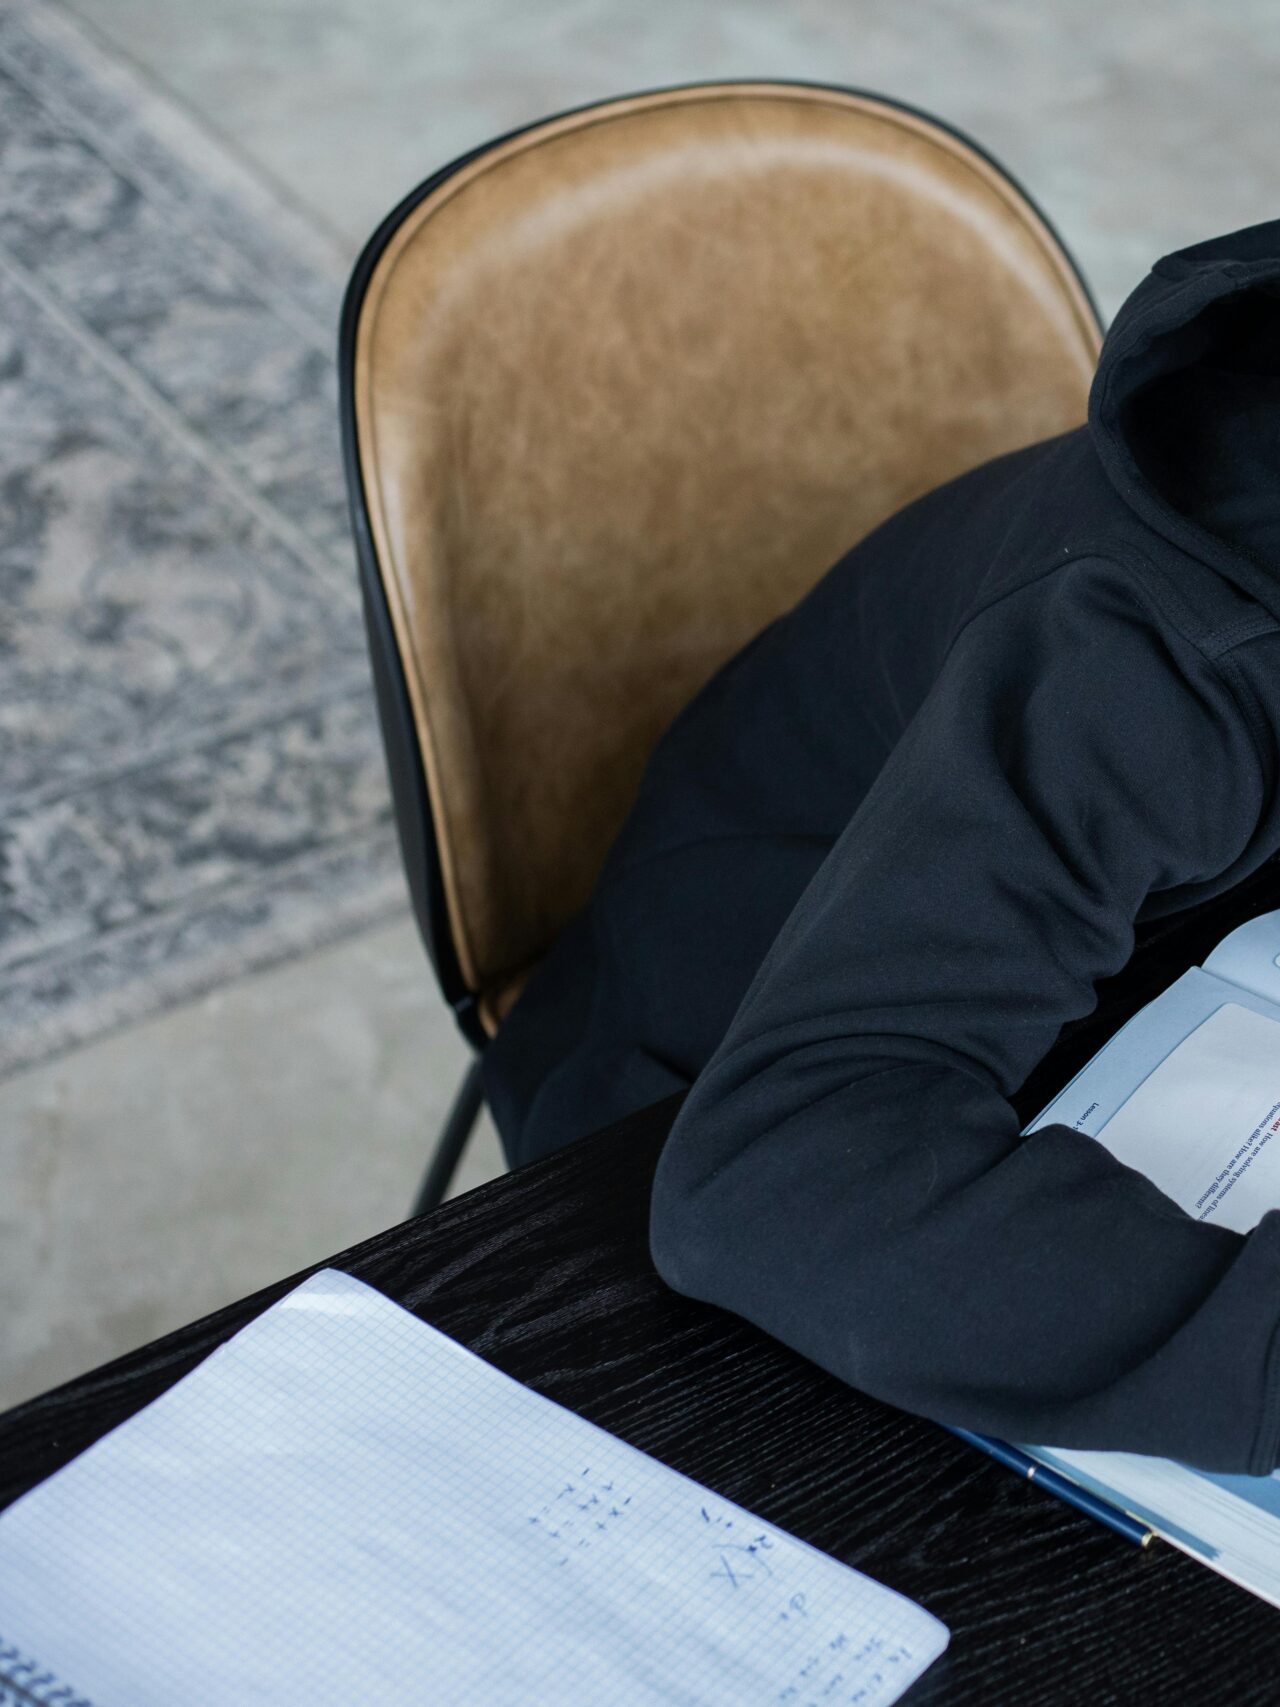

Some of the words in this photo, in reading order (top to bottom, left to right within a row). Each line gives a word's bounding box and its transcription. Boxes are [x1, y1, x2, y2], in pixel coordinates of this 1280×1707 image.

[1079, 1101, 1100, 1121] Lesson
[1245, 1127, 1261, 1146] alike?
[1258, 1131, 1273, 1147] How
[1234, 1144, 1250, 1160] How
[1250, 1145, 1261, 1157] are
[1225, 1158, 1237, 1170] are
[1231, 1156, 1253, 1178] solving
[1214, 1168, 1230, 1183] they
[1194, 1181, 1219, 1209] different?
[1216, 1176, 1237, 1200] systems
[1210, 1198, 1219, 1208] of
[1198, 1204, 1216, 1222] linea
